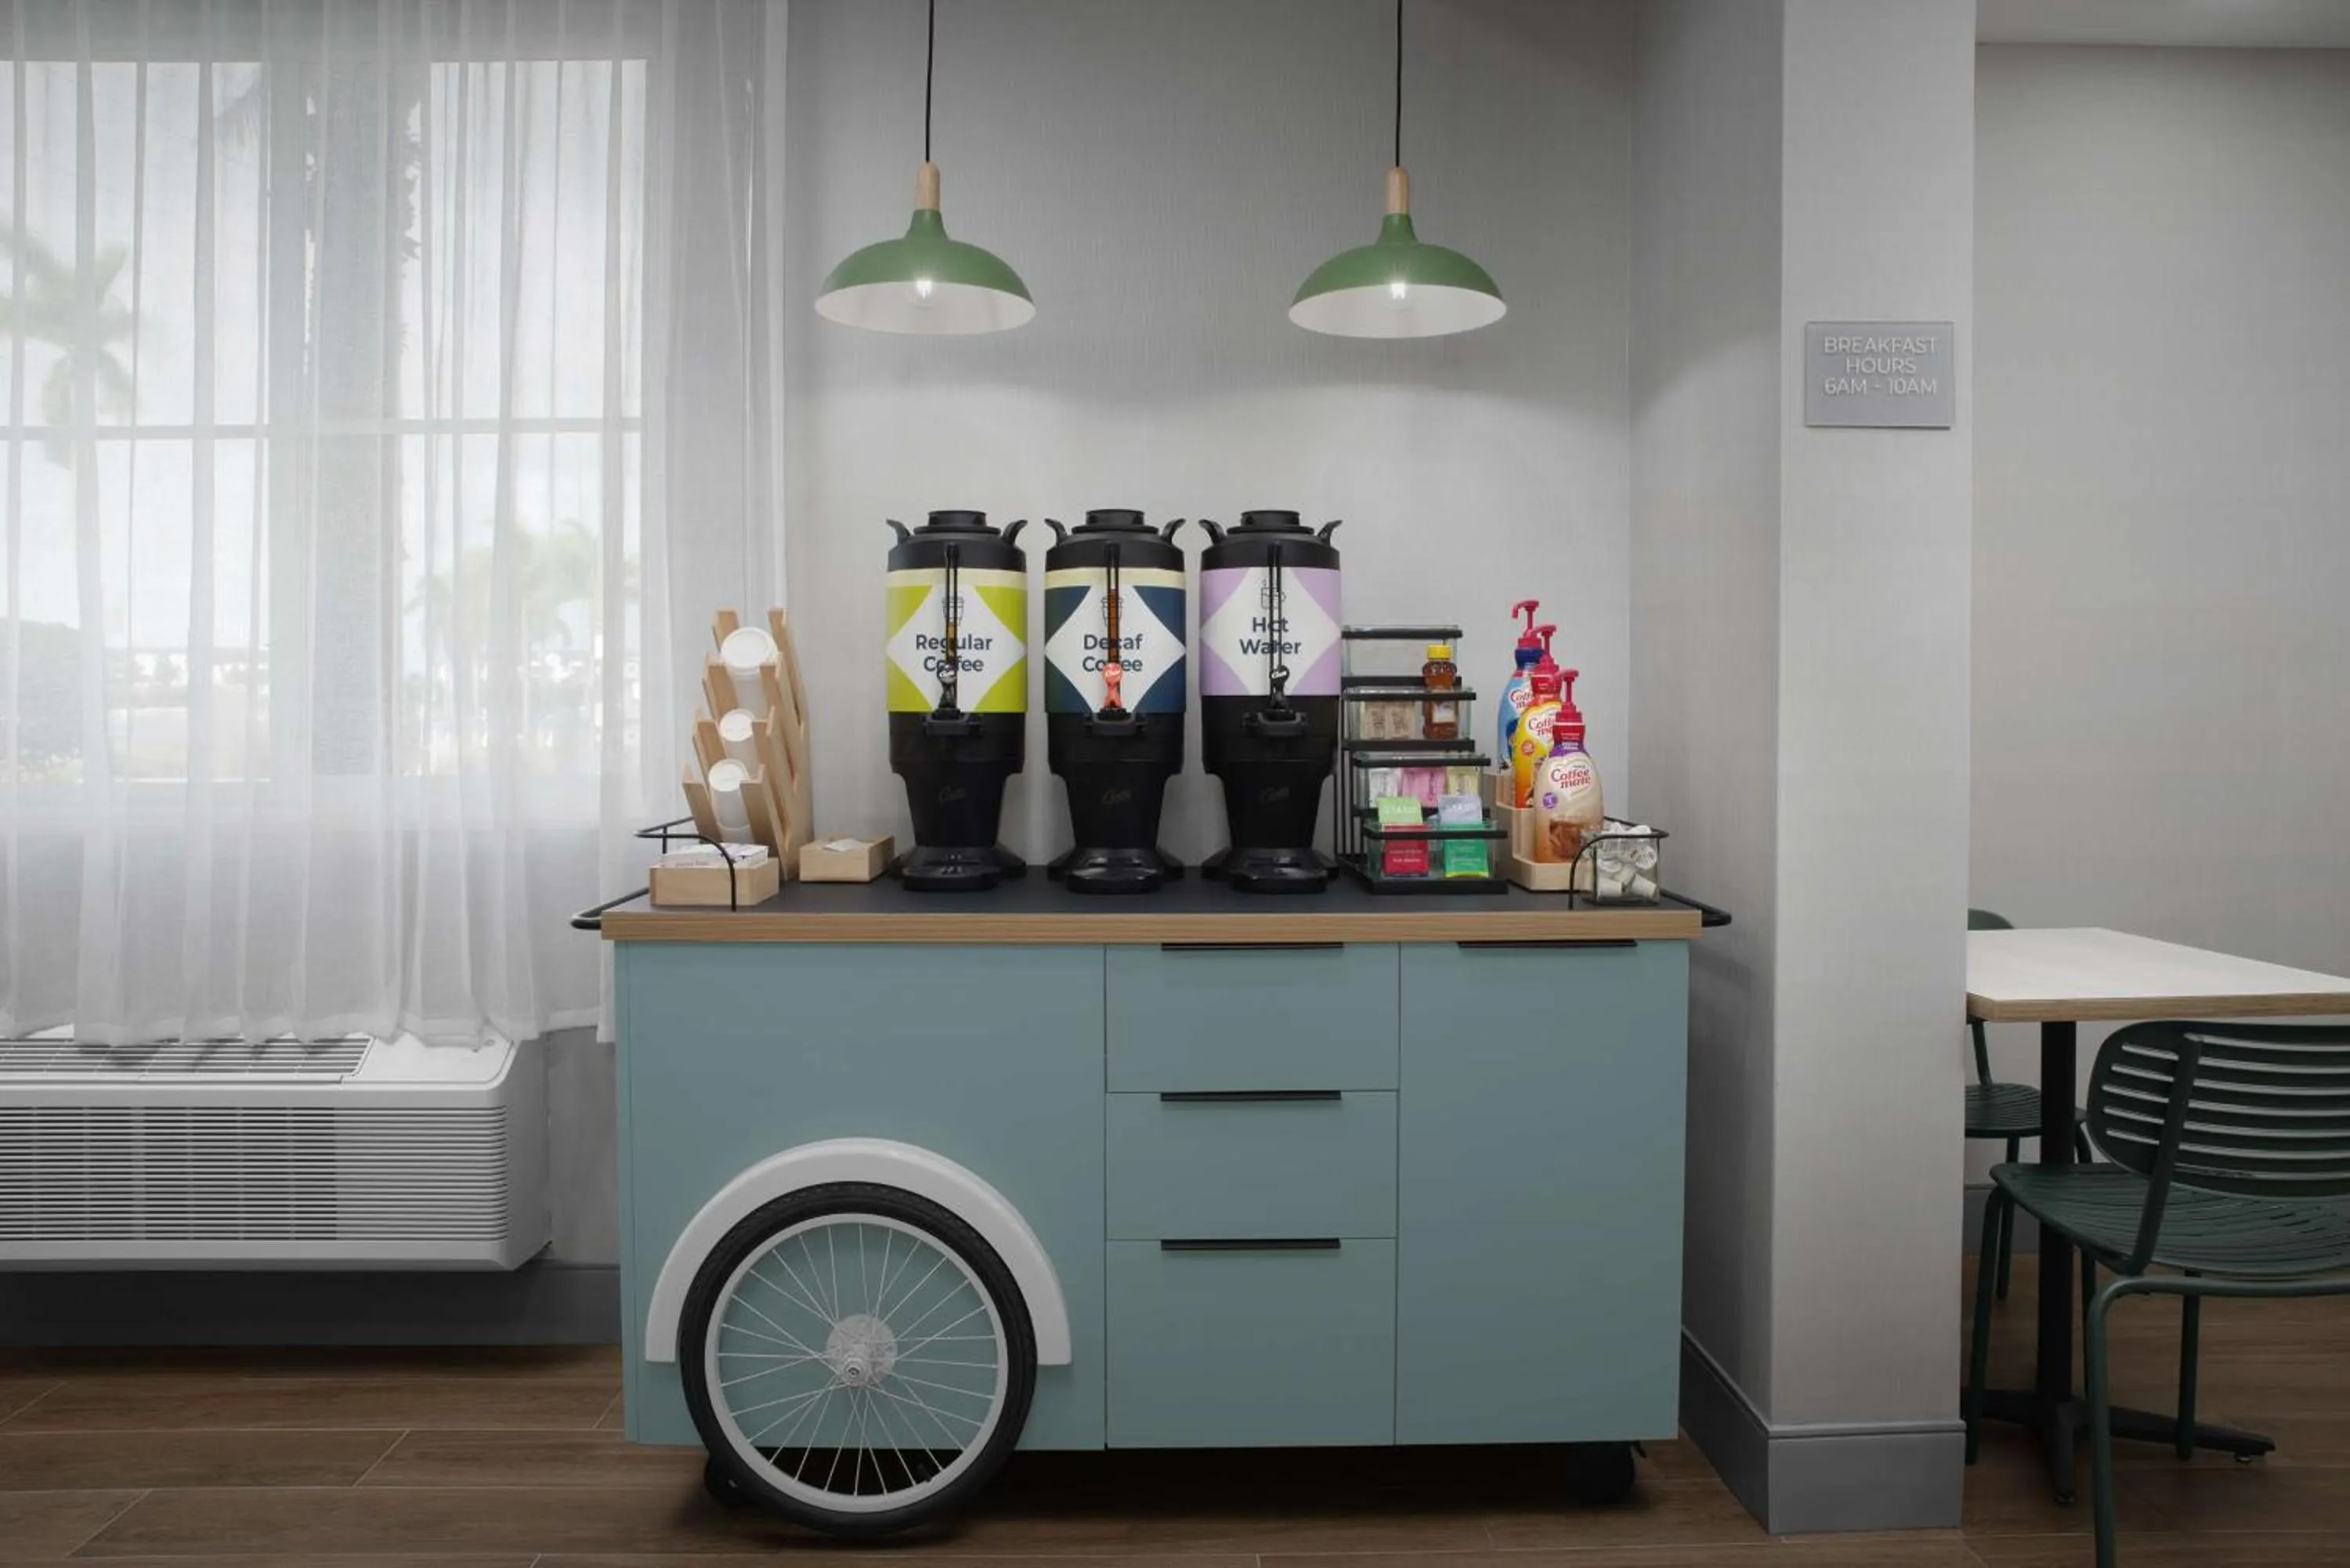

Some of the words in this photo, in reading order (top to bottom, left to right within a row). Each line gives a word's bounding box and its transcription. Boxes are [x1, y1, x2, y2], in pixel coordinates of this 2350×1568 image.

[1824, 336, 1938, 353] BREAKFAST
[1846, 356, 1917, 374] HOURS
[1824, 378, 1867, 395] 6AM
[1889, 378, 1937, 395] 10AM
[1252, 616, 1289, 633] Hot
[1083, 633, 1144, 650] Deaf
[1238, 638, 1303, 655] Water
[923, 655, 985, 672] Cofee
[1082, 655, 1143, 672] Coee
[1528, 717, 1554, 731] Coff
[1550, 768, 1590, 782] Coffee
